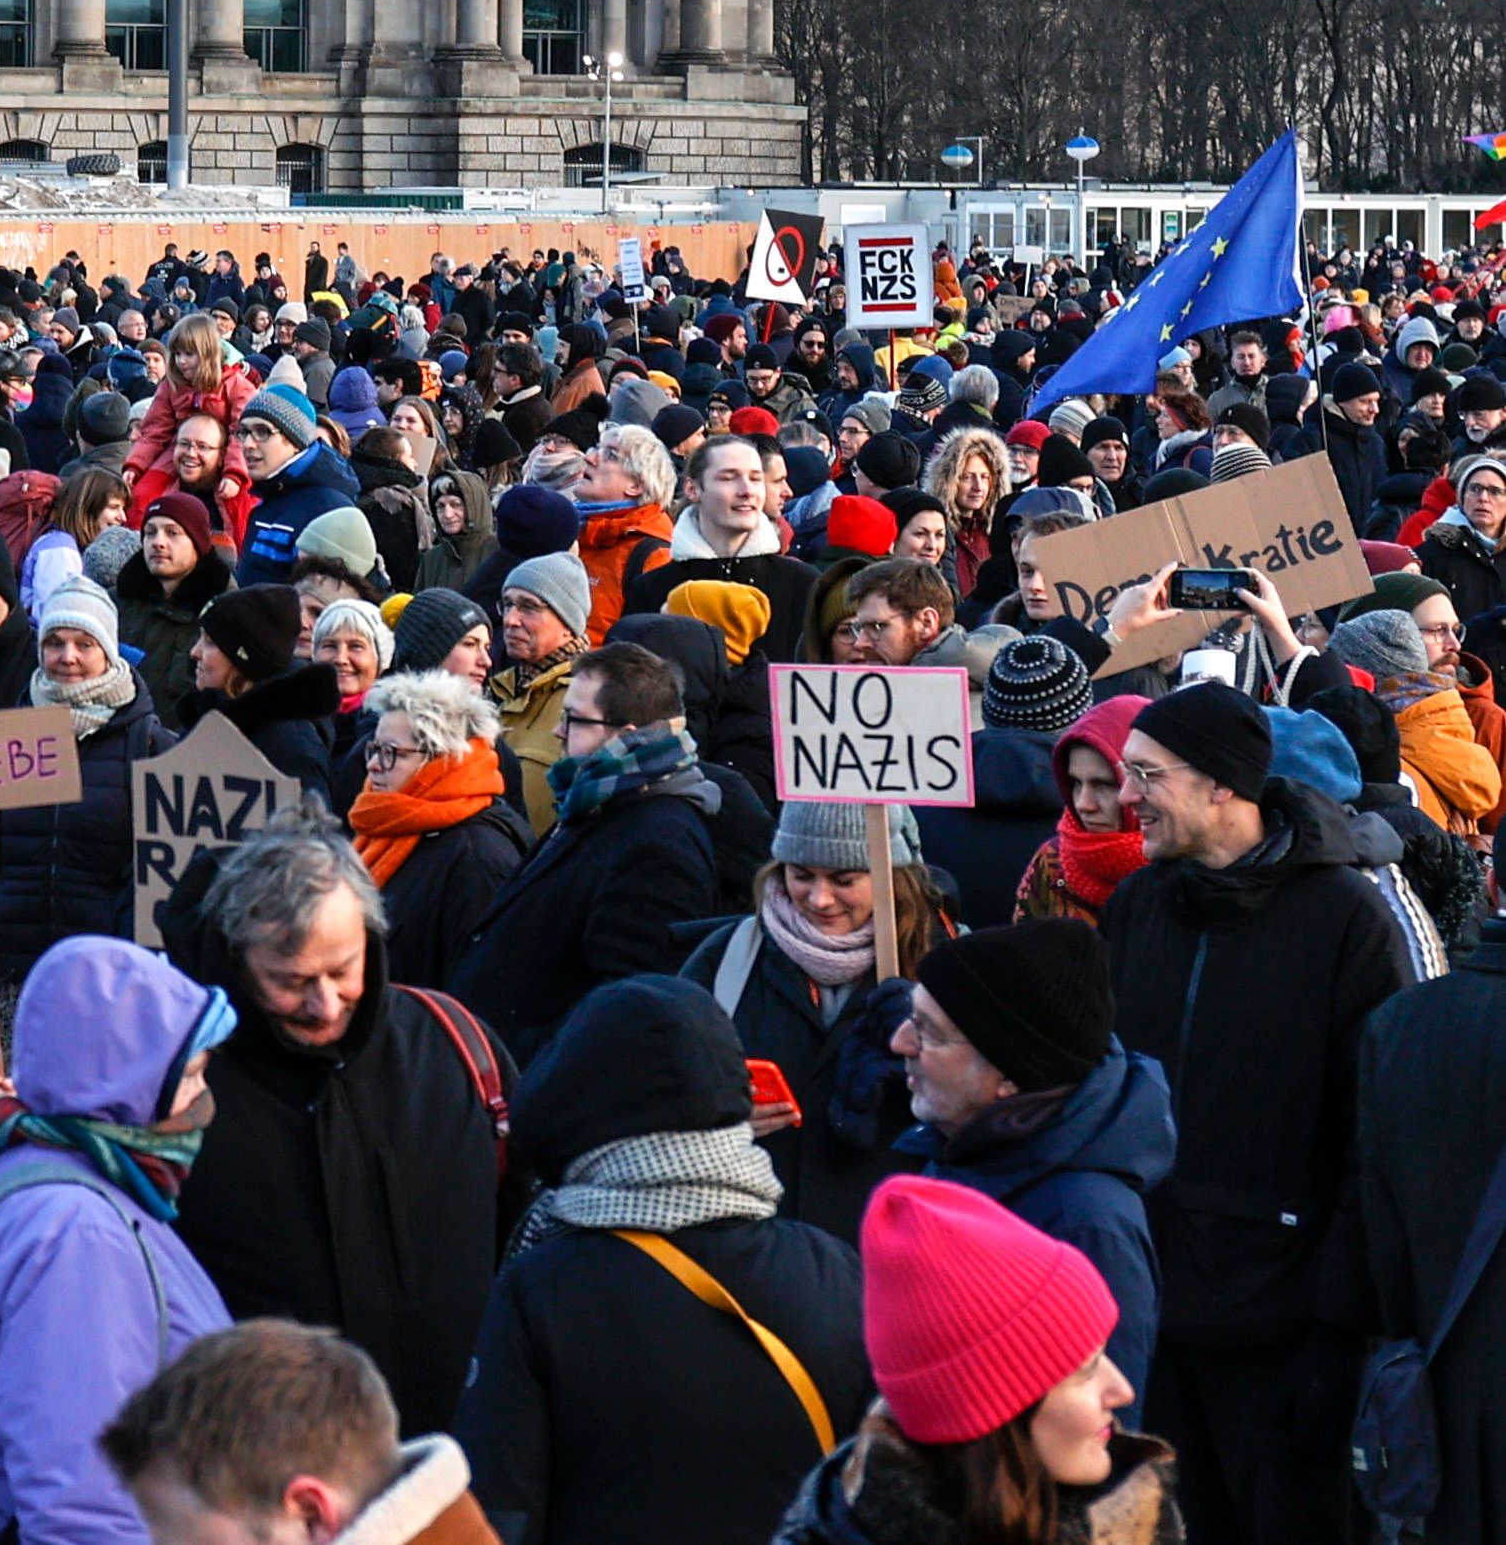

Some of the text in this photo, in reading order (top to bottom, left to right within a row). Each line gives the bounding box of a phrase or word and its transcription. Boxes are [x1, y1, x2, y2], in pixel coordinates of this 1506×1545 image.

[859, 249, 914, 275] FCK
[861, 274, 917, 301] NZS
[791, 671, 893, 730] NO
[793, 733, 961, 792] NAZIS
